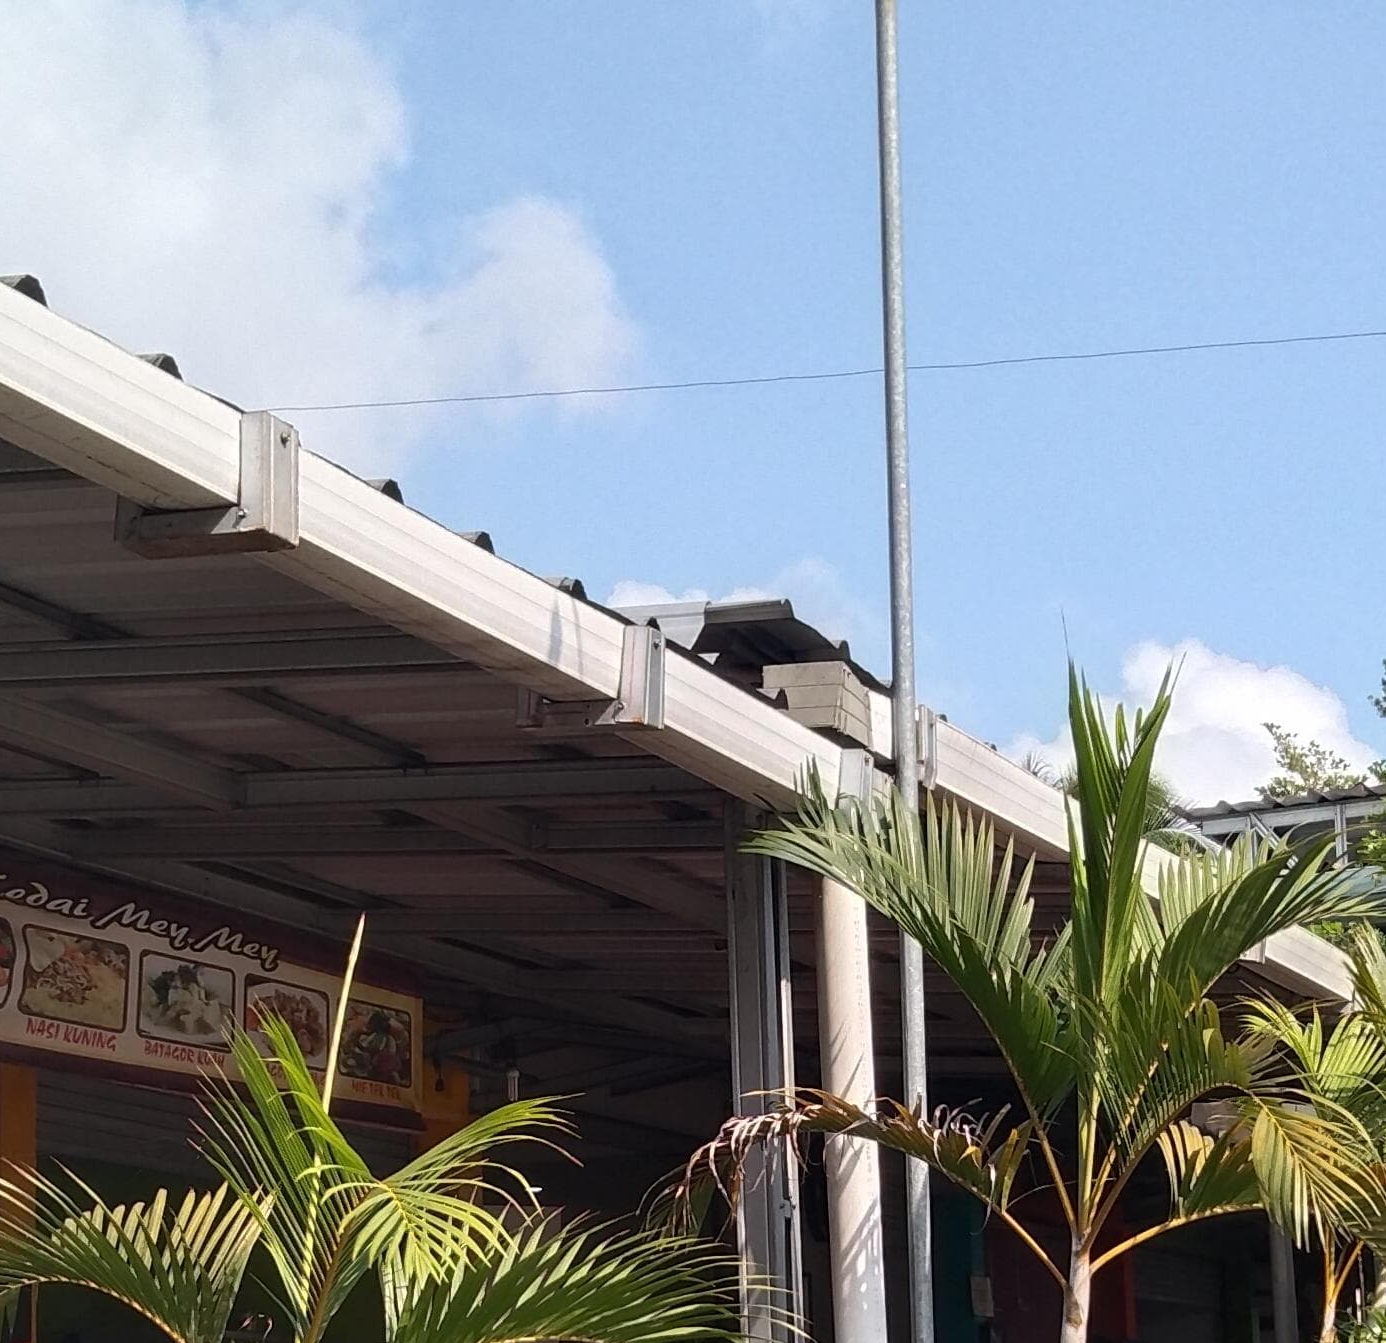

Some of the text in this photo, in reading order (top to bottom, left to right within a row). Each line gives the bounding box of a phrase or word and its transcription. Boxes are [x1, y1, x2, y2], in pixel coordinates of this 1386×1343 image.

[94, 902, 190, 948] Mey
[193, 926, 279, 969] Mey
[25, 1017, 118, 1052] NASI KUNING
[144, 1040, 194, 1063] BATAGOR
